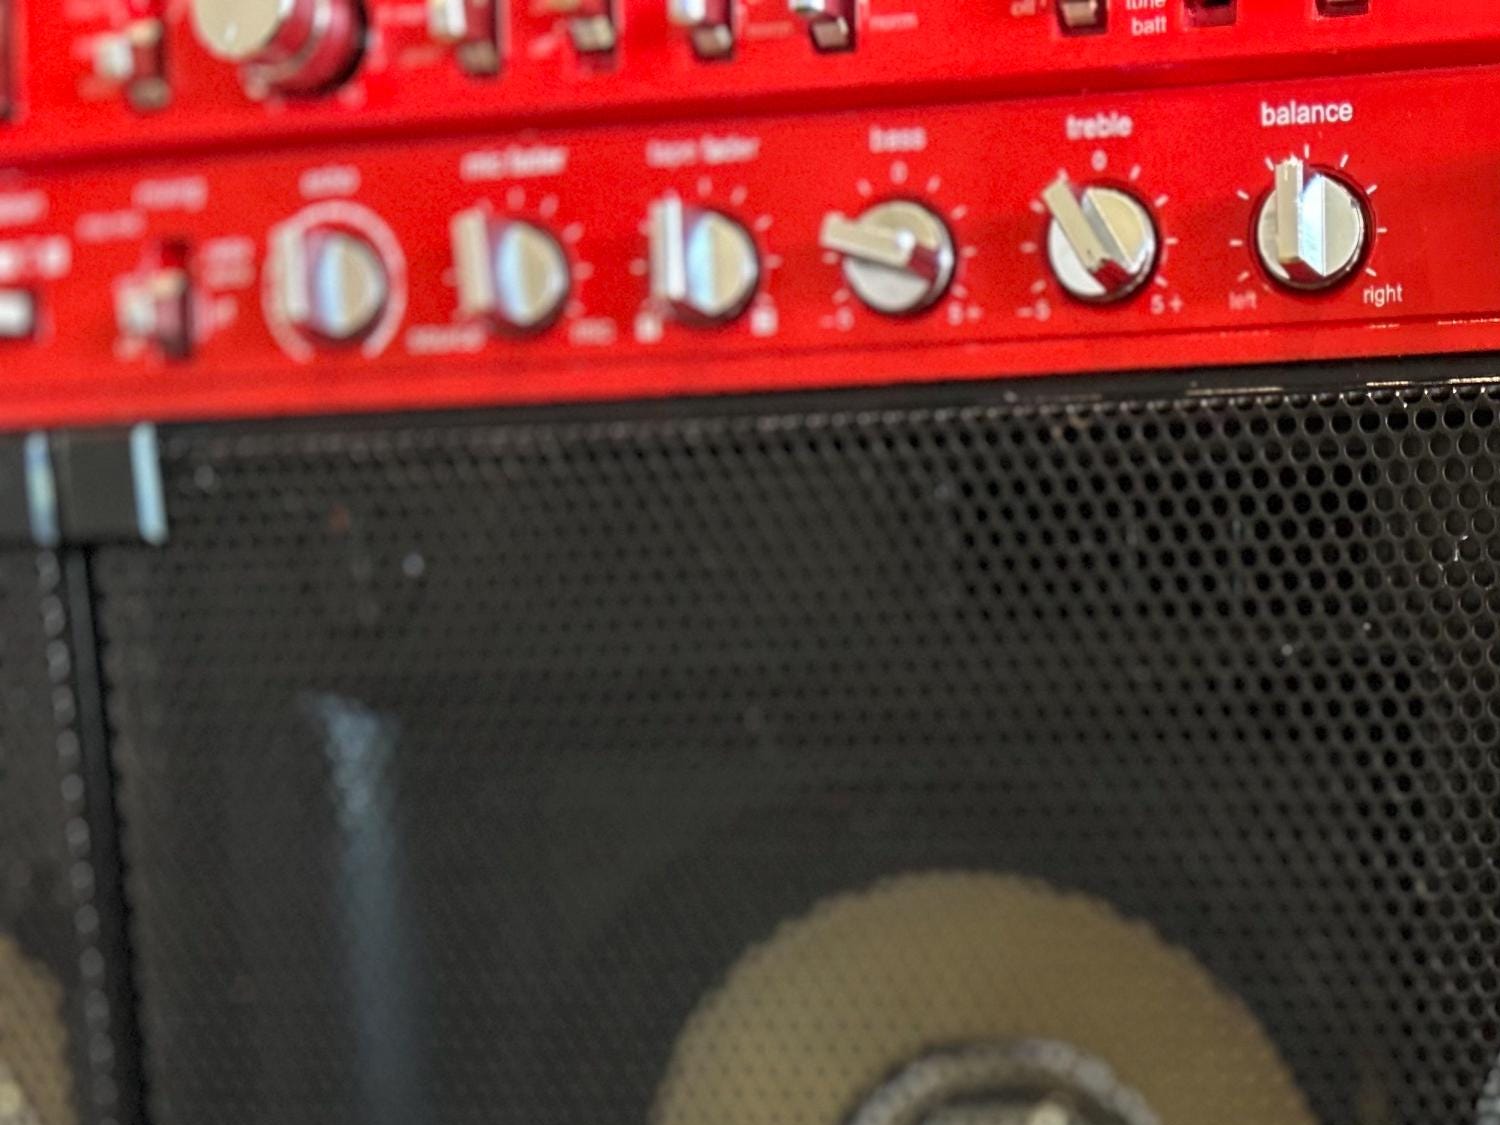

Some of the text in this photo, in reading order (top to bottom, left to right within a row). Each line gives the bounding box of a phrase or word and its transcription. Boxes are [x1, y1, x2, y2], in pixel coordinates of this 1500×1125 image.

[1131, 16, 1167, 36] batt
[1066, 112, 1133, 139] treble
[1260, 101, 1354, 127] balance
[1363, 285, 1402, 306] right
